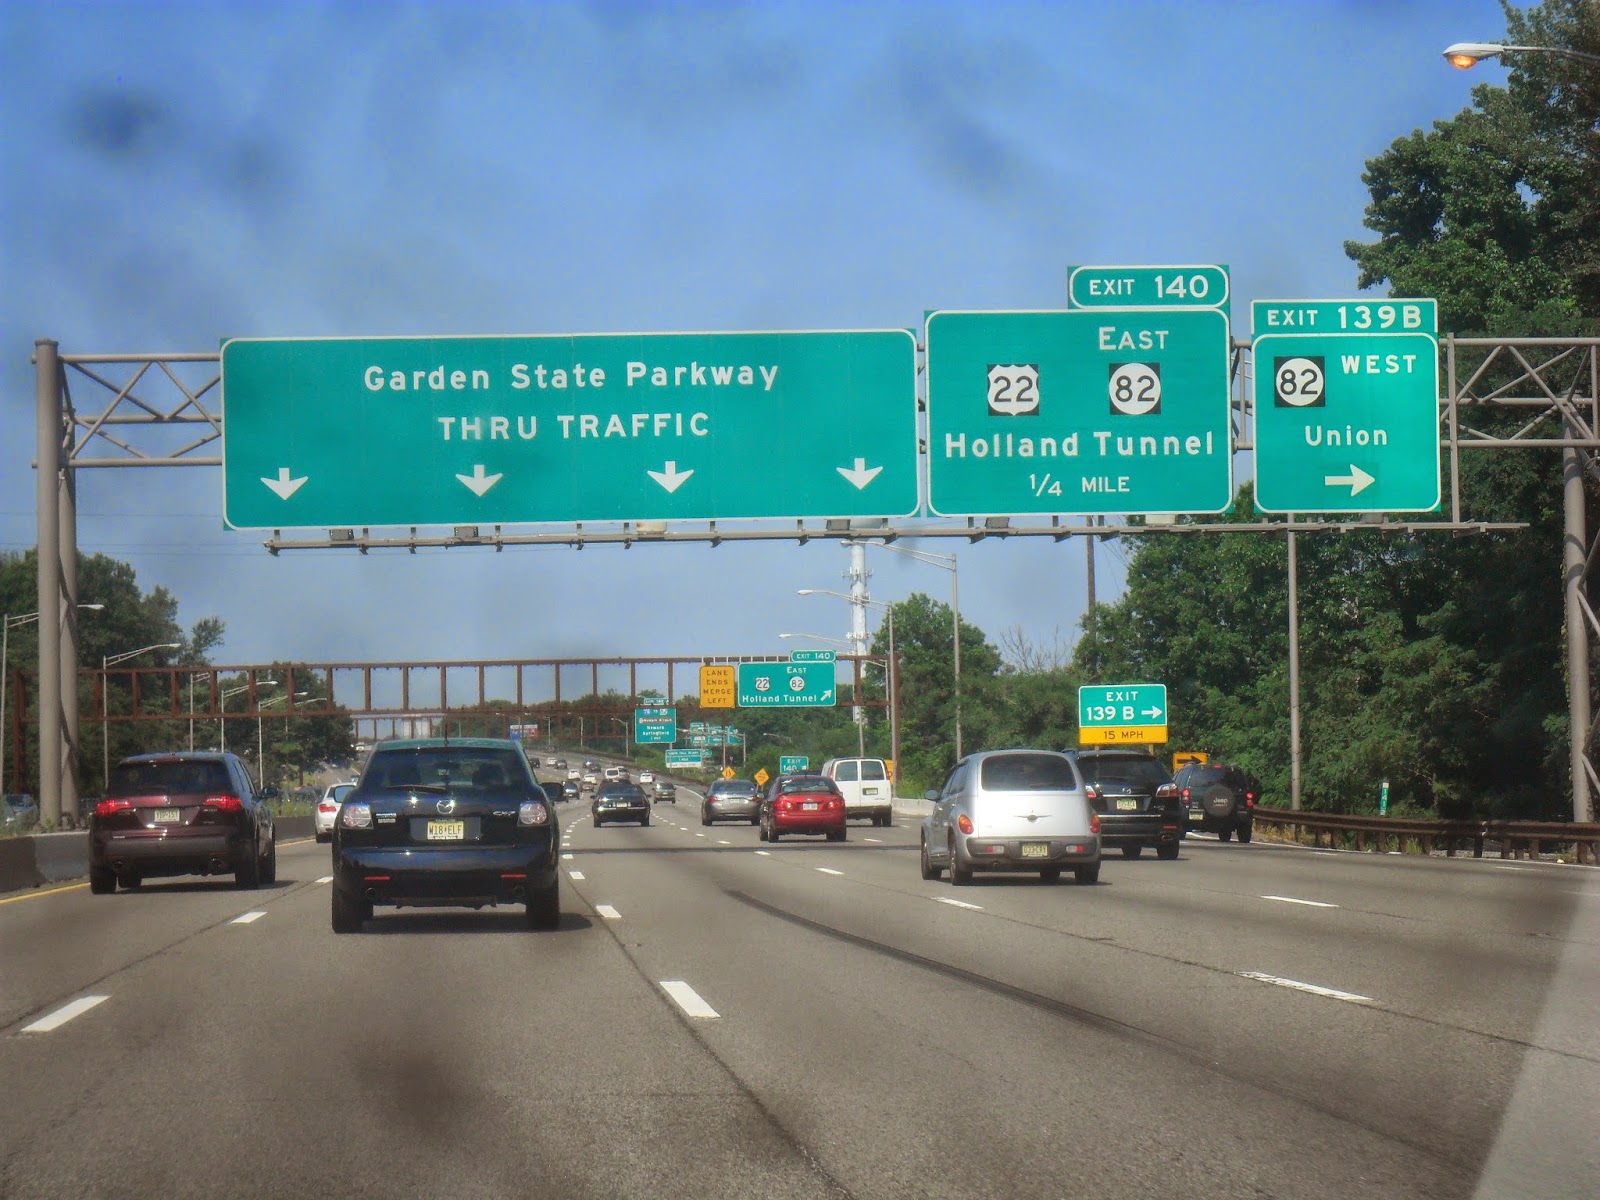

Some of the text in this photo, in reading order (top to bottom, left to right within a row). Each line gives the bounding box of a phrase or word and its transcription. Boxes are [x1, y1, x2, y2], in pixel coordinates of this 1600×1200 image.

[1089, 275, 1209, 299] EXIT 140
[1267, 305, 1422, 329] EXIT 139B
[1099, 326, 1169, 350] EAST
[1341, 355, 1417, 374] WEST
[364, 361, 779, 391] Garden State Parkway
[1281, 369, 1319, 395] 82
[993, 375, 1034, 403] 22
[1114, 375, 1156, 402] 82
[438, 412, 709, 441] THRU TRAFFIC
[1305, 425, 1387, 446] Union
[945, 431, 1213, 458] Holland Tunnel
[1030, 473, 1130, 497] 1/4 MILE
[815, 652, 830, 660] 140
[786, 666, 807, 674] EAST
[756, 678, 769, 689] 22
[791, 679, 803, 688] 82
[742, 694, 817, 703] Holland Tunnel
[1106, 691, 1139, 702] EXIT
[1086, 705, 1135, 721] 139 B
[1103, 730, 1144, 740] 15 MPH
